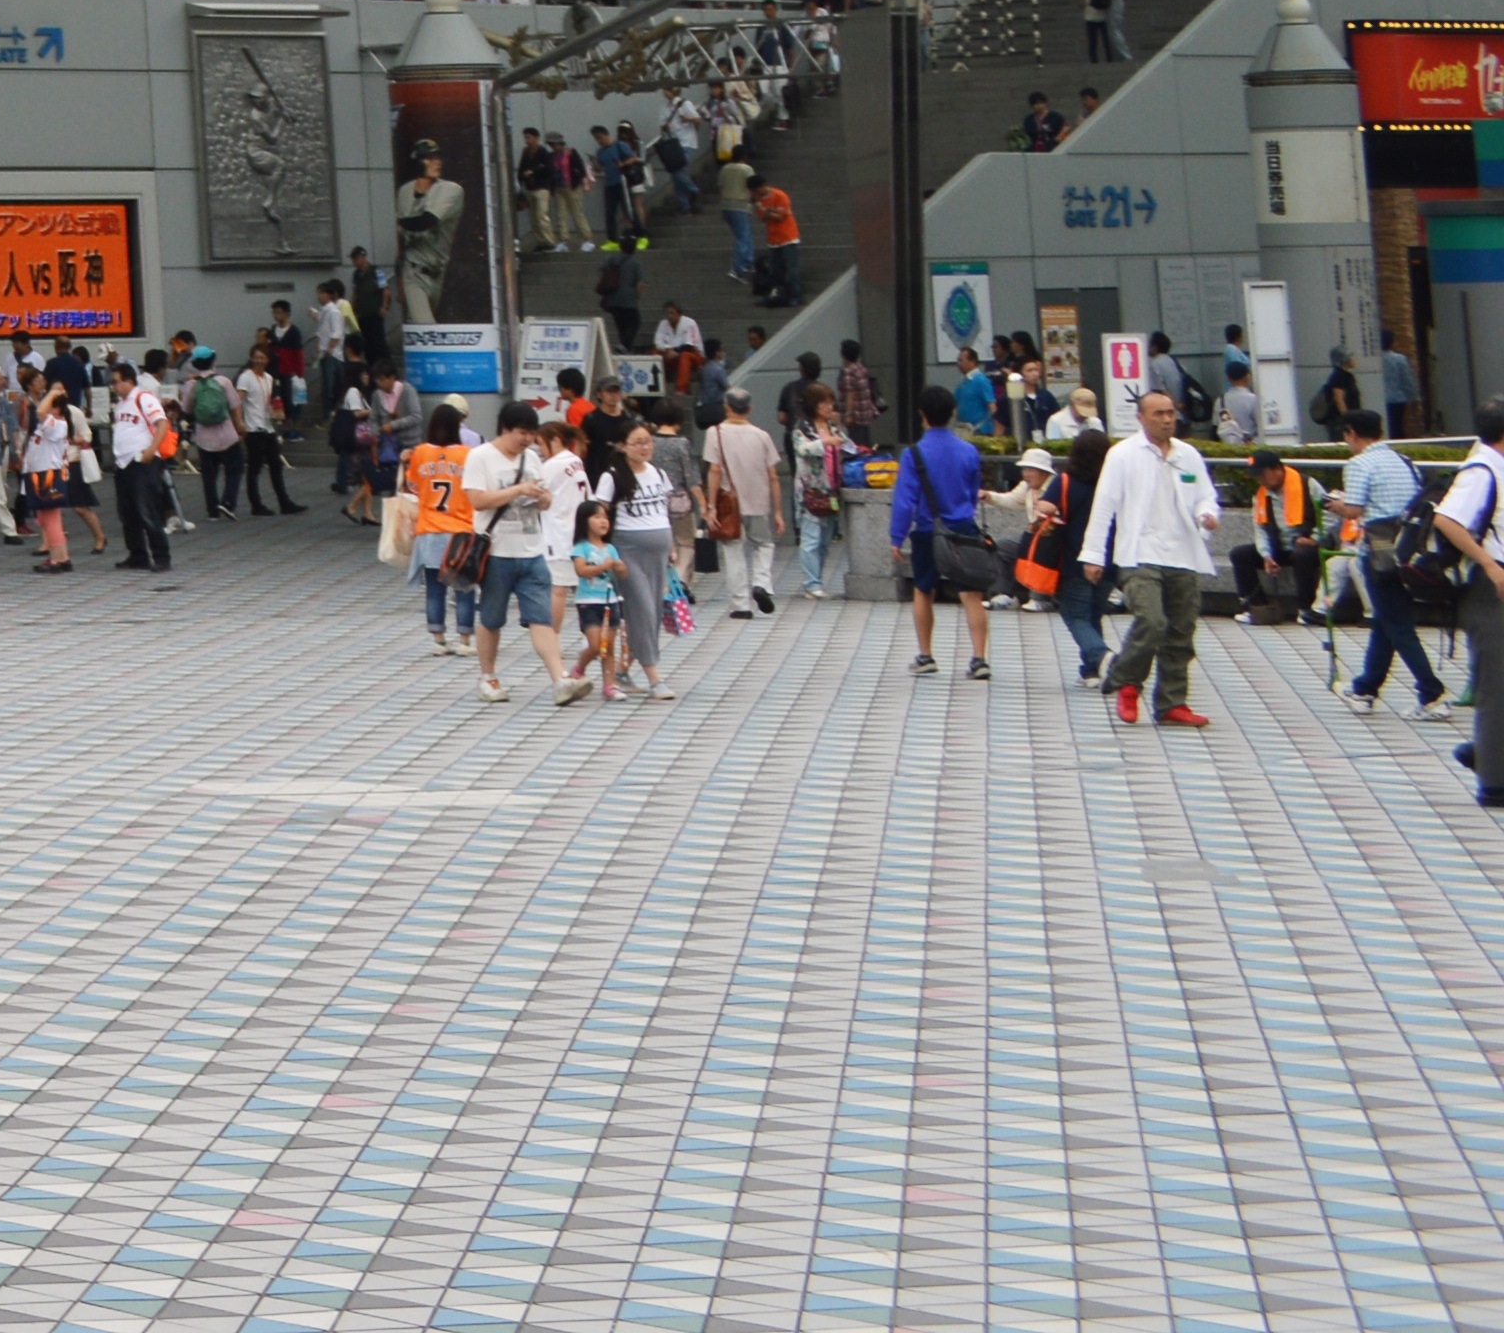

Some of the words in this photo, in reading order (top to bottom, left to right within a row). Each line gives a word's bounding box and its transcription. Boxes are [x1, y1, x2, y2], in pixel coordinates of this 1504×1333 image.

[1063, 185, 1097, 207] ゲート
[1100, 185, 1132, 228] 21
[1065, 209, 1097, 228] GATE
[431, 480, 452, 513] 7
